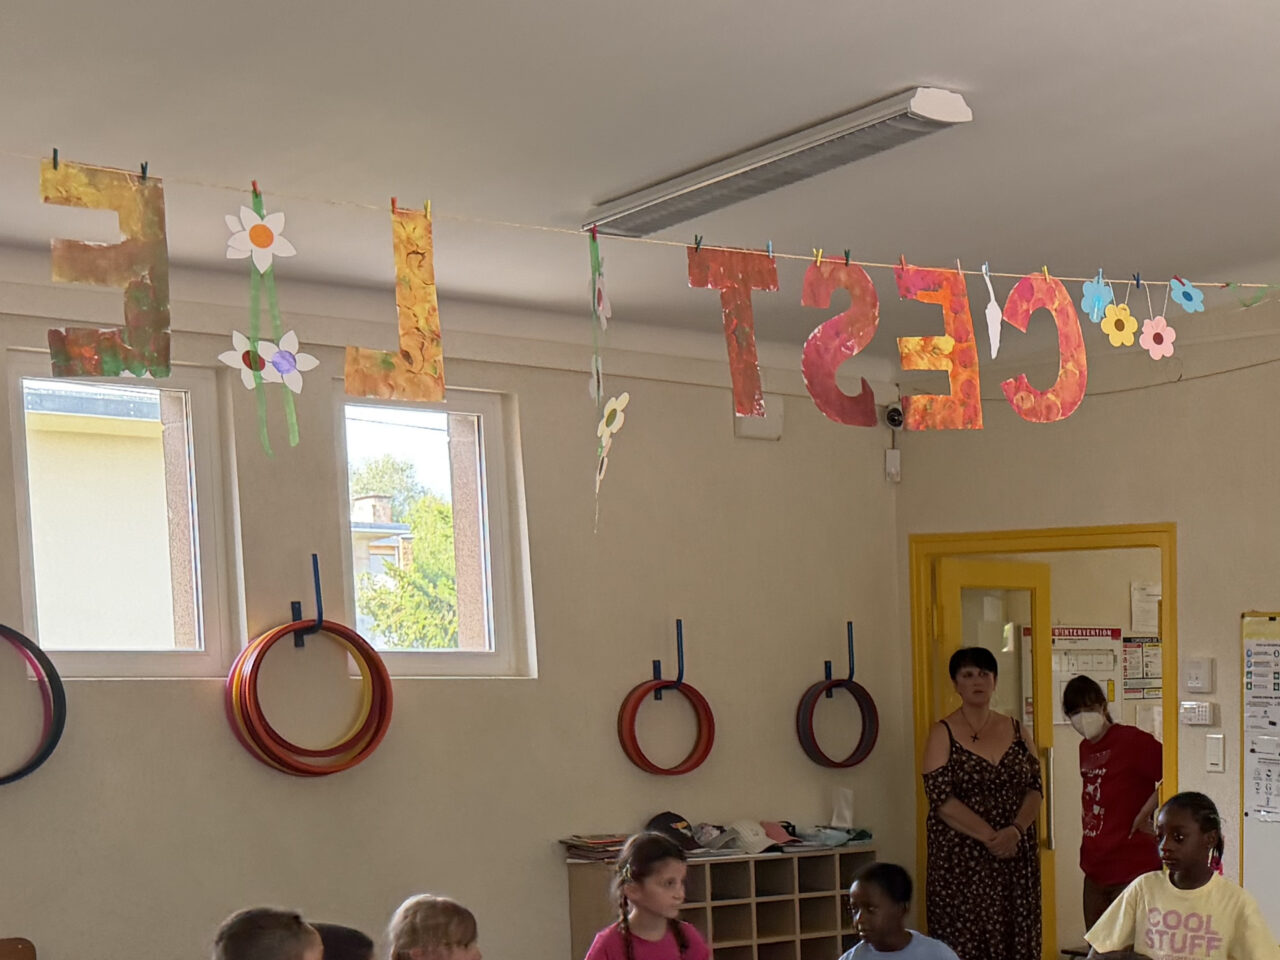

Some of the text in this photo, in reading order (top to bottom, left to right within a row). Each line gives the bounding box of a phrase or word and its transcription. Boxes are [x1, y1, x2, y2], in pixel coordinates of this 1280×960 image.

[1054, 628, 1112, 637] D'INTERVENTION
[1148, 907, 1220, 936] COOL
[1145, 928, 1223, 957] STUFF
